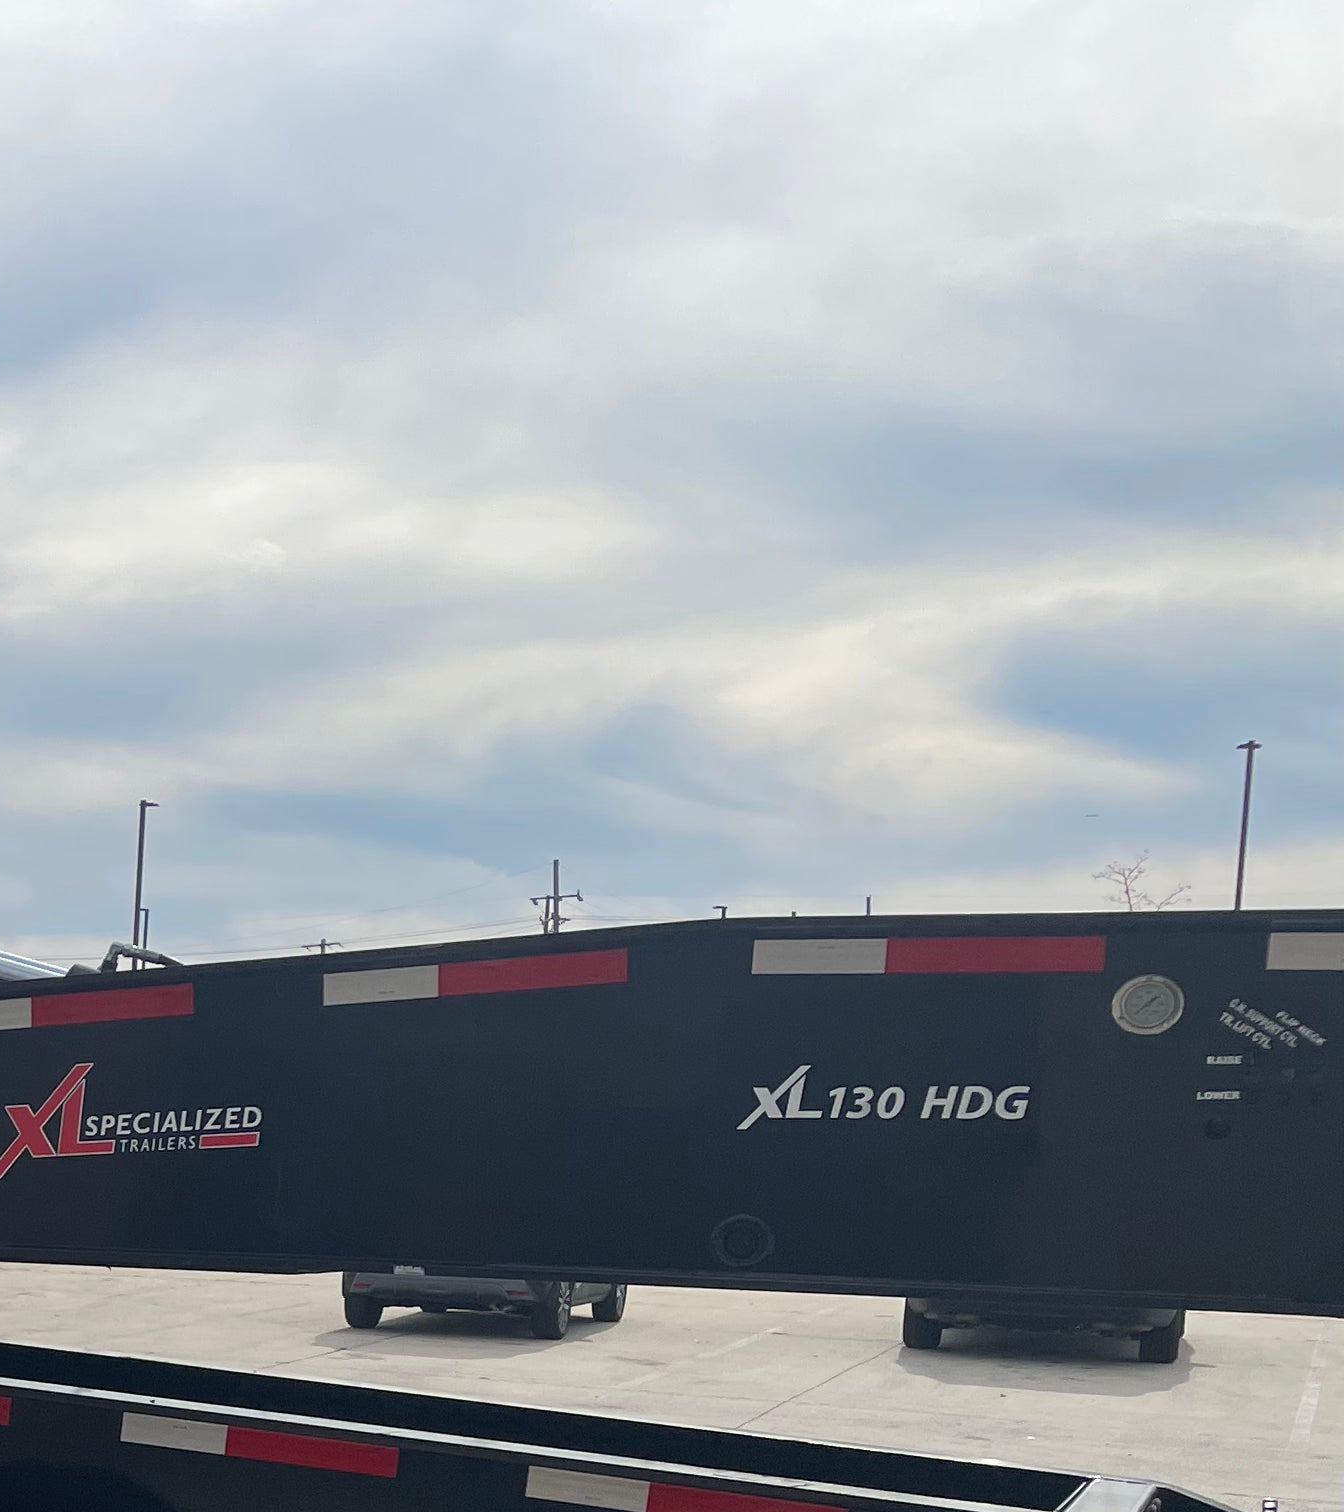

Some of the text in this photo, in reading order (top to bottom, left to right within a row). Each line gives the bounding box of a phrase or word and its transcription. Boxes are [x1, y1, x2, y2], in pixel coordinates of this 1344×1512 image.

[920, 1085, 1031, 1121] HDG
[1196, 1090, 1241, 1100] LOWER
[84, 1106, 262, 1137] SPECIALIZED
[120, 1135, 196, 1153] TRAILERS
